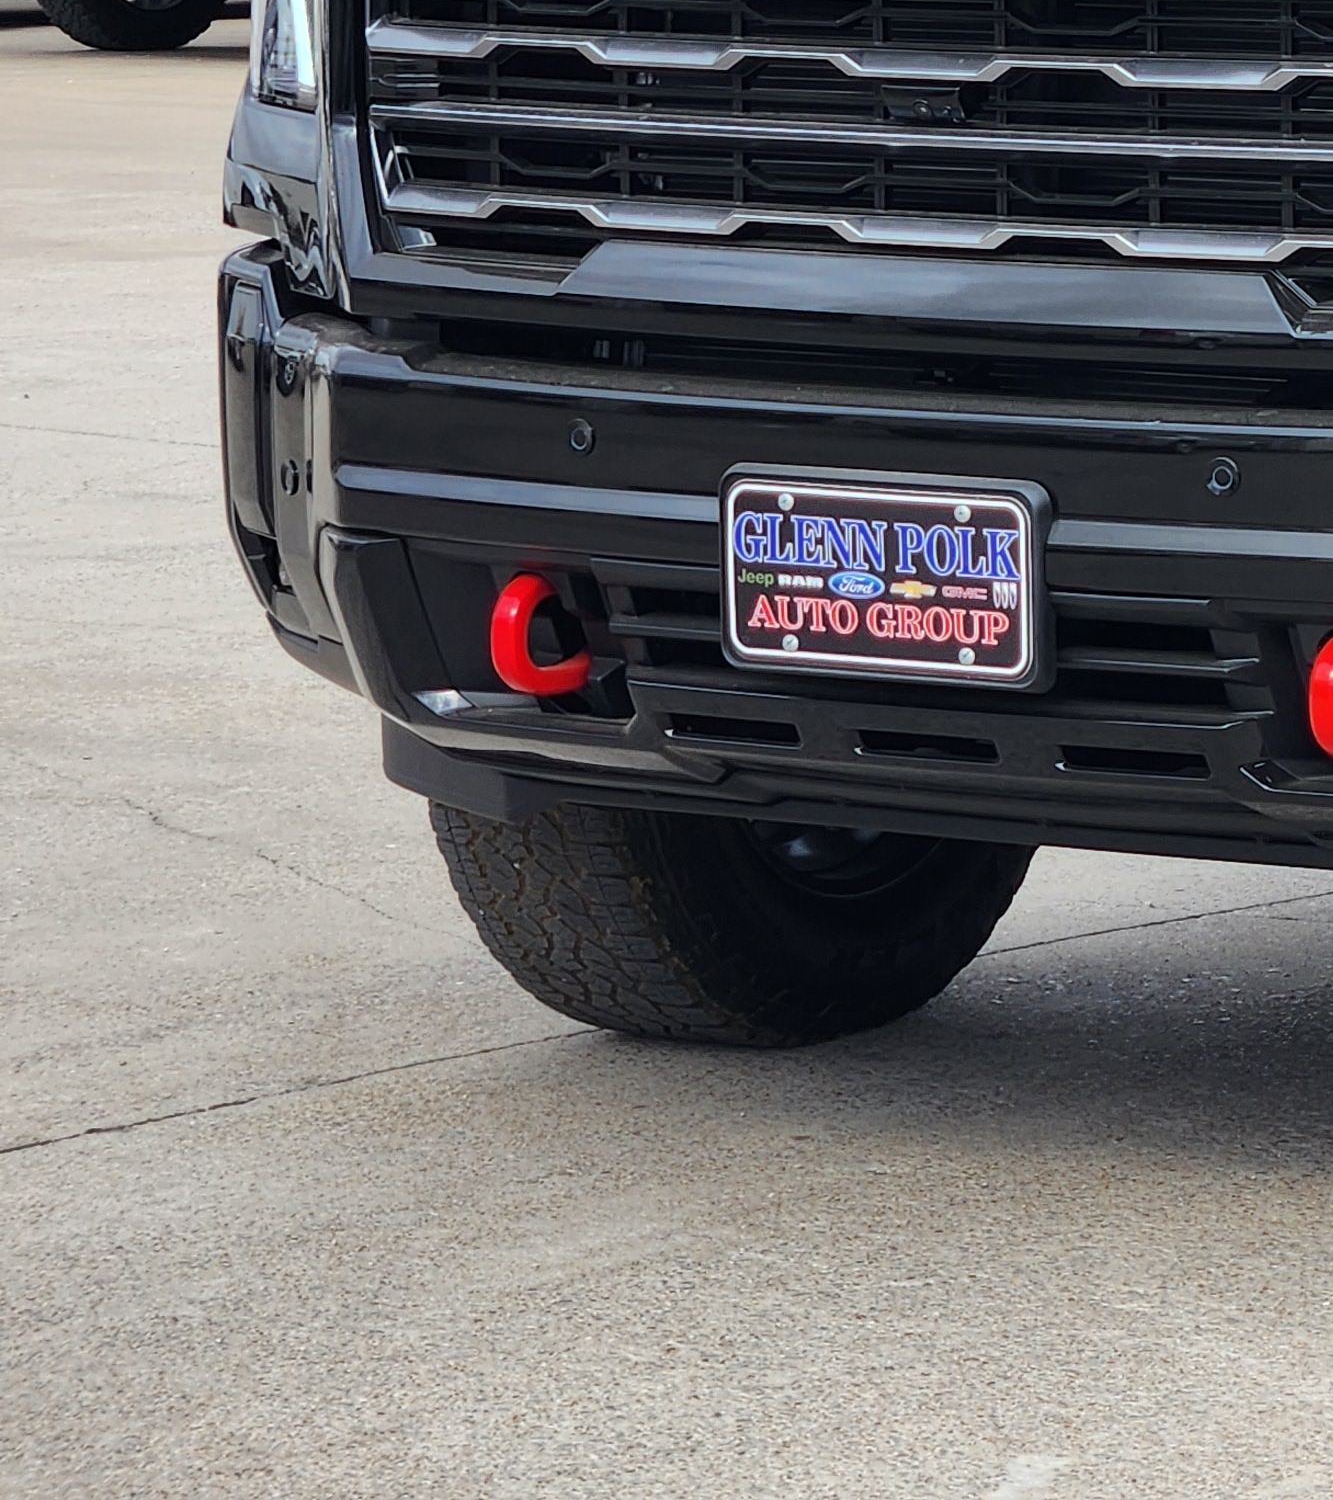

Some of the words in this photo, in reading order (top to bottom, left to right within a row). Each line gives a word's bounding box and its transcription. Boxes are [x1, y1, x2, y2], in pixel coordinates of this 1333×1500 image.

[733, 510, 887, 572] GLENN
[894, 522, 1022, 581] POLK
[737, 567, 775, 588] Jeep
[778, 573, 824, 589] RAM
[838, 575, 875, 595] Ford
[941, 585, 988, 600] GMC
[747, 593, 859, 636] AUTO
[866, 601, 1011, 647] GROUP
